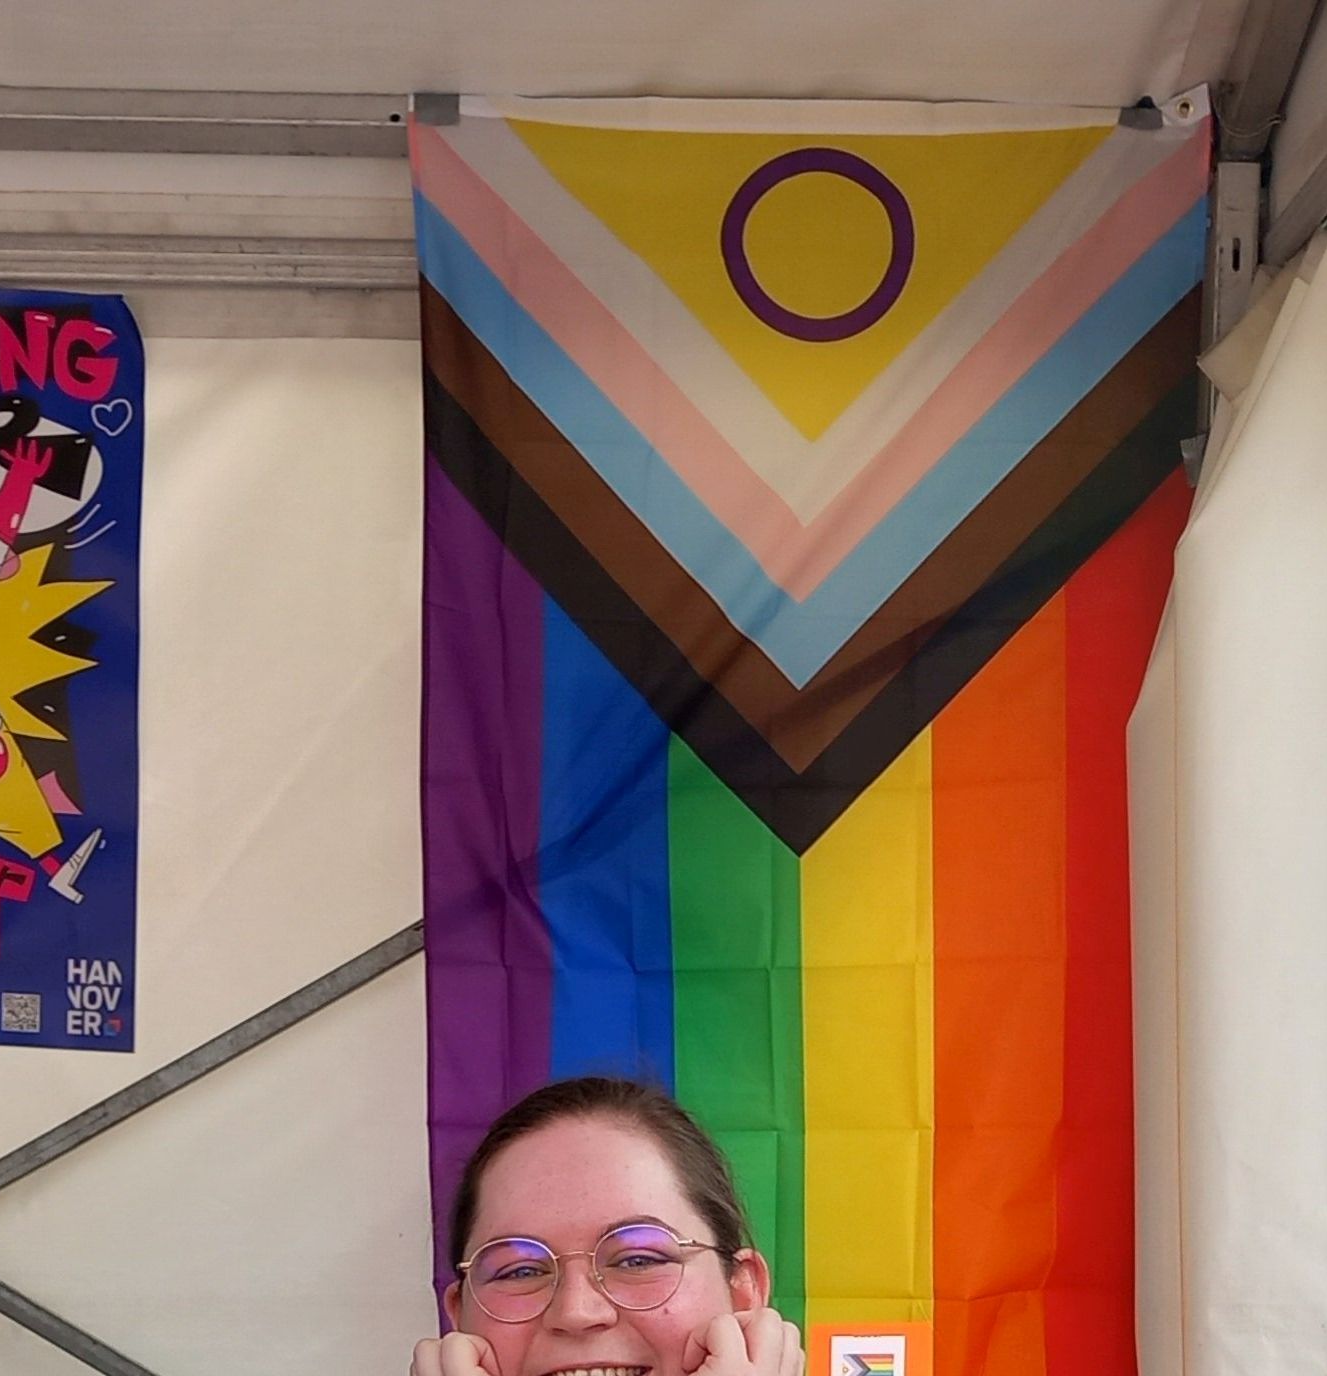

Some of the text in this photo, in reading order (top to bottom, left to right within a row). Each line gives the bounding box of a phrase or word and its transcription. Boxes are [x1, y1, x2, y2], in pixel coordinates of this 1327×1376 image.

[67, 959, 121, 984] HAN
[67, 986, 121, 1011] NOV
[66, 1011, 102, 1036] ER
